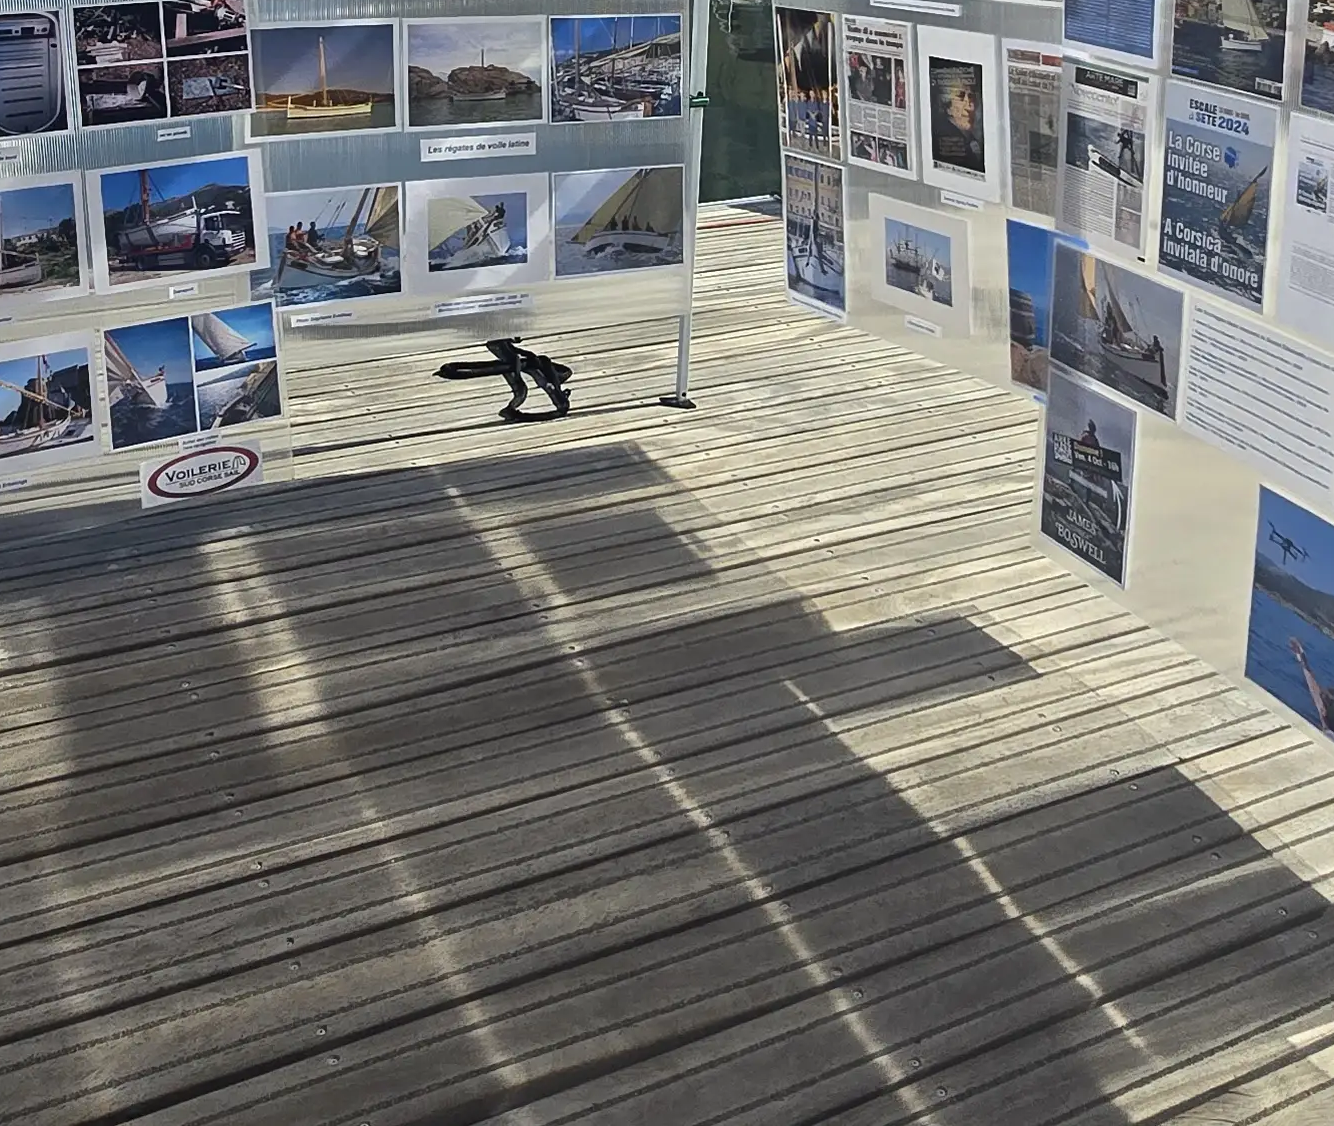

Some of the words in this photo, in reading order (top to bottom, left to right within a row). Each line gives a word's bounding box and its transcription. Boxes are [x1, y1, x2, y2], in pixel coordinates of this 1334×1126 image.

[1189, 99, 1217, 115] ESCALE
[1218, 117, 1249, 136] 2024
[1169, 131, 1182, 149] La
[1186, 136, 1220, 161] Corse
[1168, 149, 1208, 178] invitée
[1167, 170, 1228, 203] d'honneur
[1164, 218, 1173, 236] A
[1176, 222, 1221, 253] Corsica
[1164, 236, 1207, 268] invitata
[1211, 257, 1258, 287] d'onore
[165, 460, 231, 482] VOILERIE
[1066, 510, 1099, 534] JAMES
[1057, 523, 1106, 564] BOSWELL
